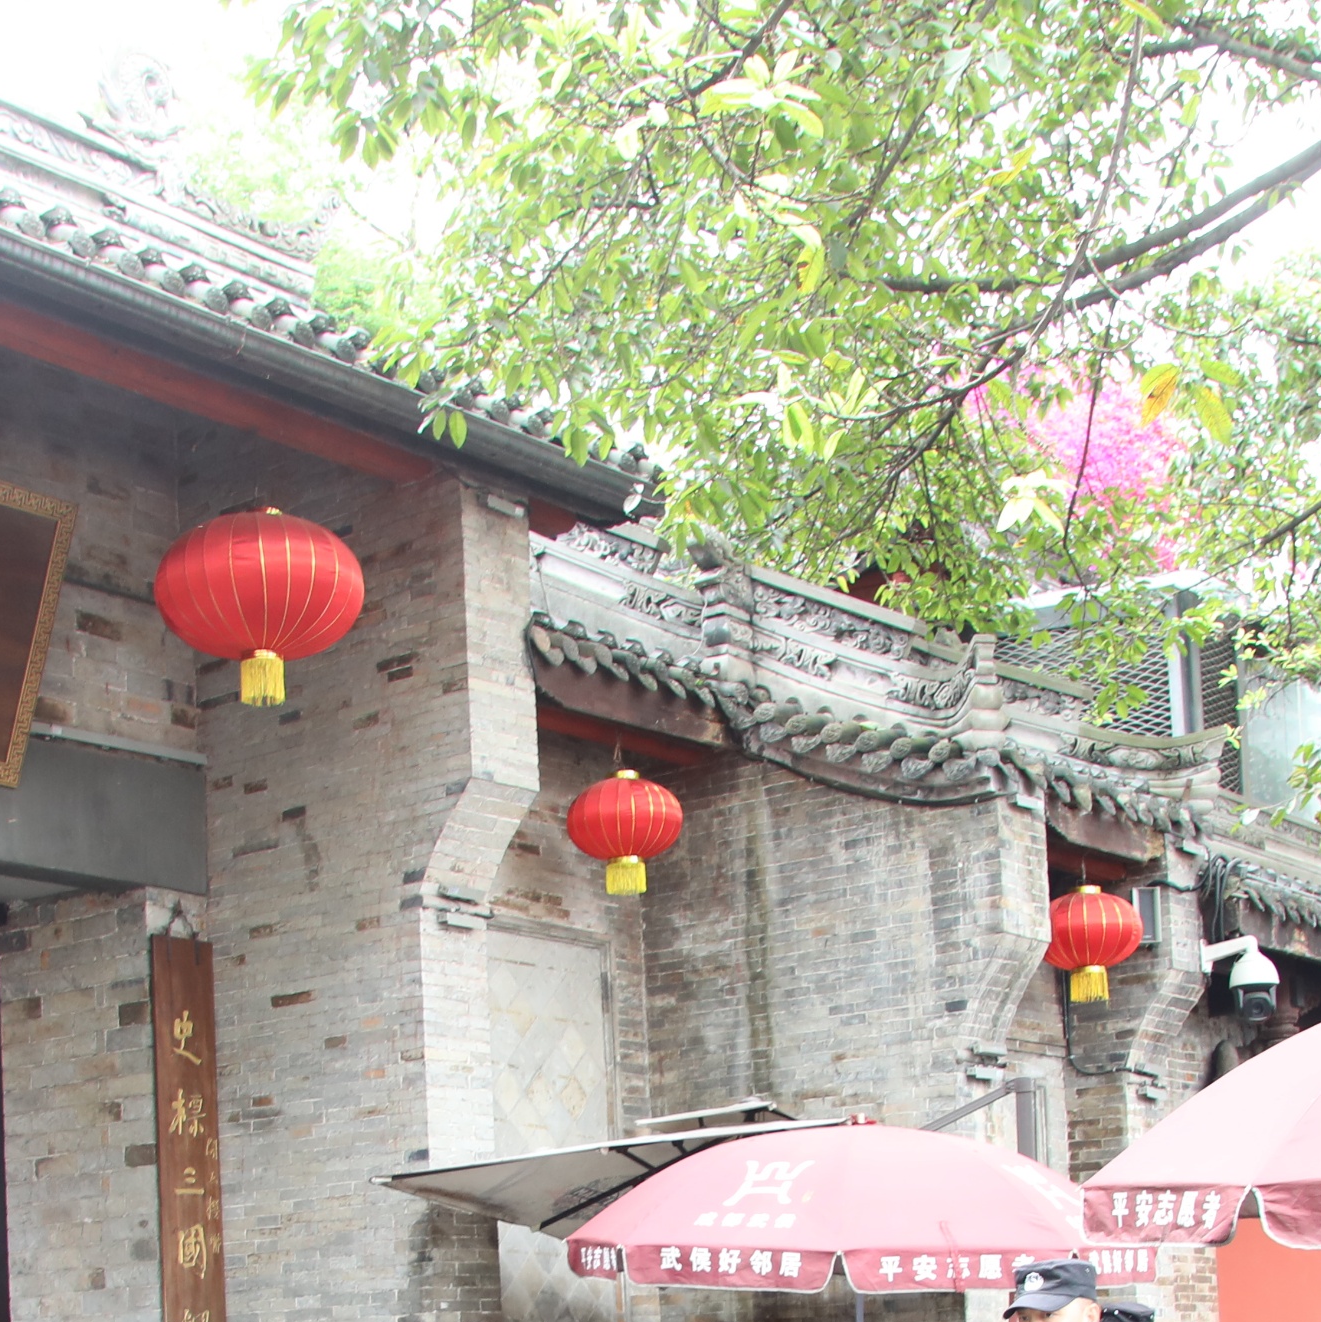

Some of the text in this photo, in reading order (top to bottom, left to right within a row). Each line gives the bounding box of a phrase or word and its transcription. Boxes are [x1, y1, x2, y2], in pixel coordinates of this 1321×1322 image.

[1111, 1189, 1222, 1230] 平安志愿者
[659, 1245, 803, 1279] 武侯好邻居
